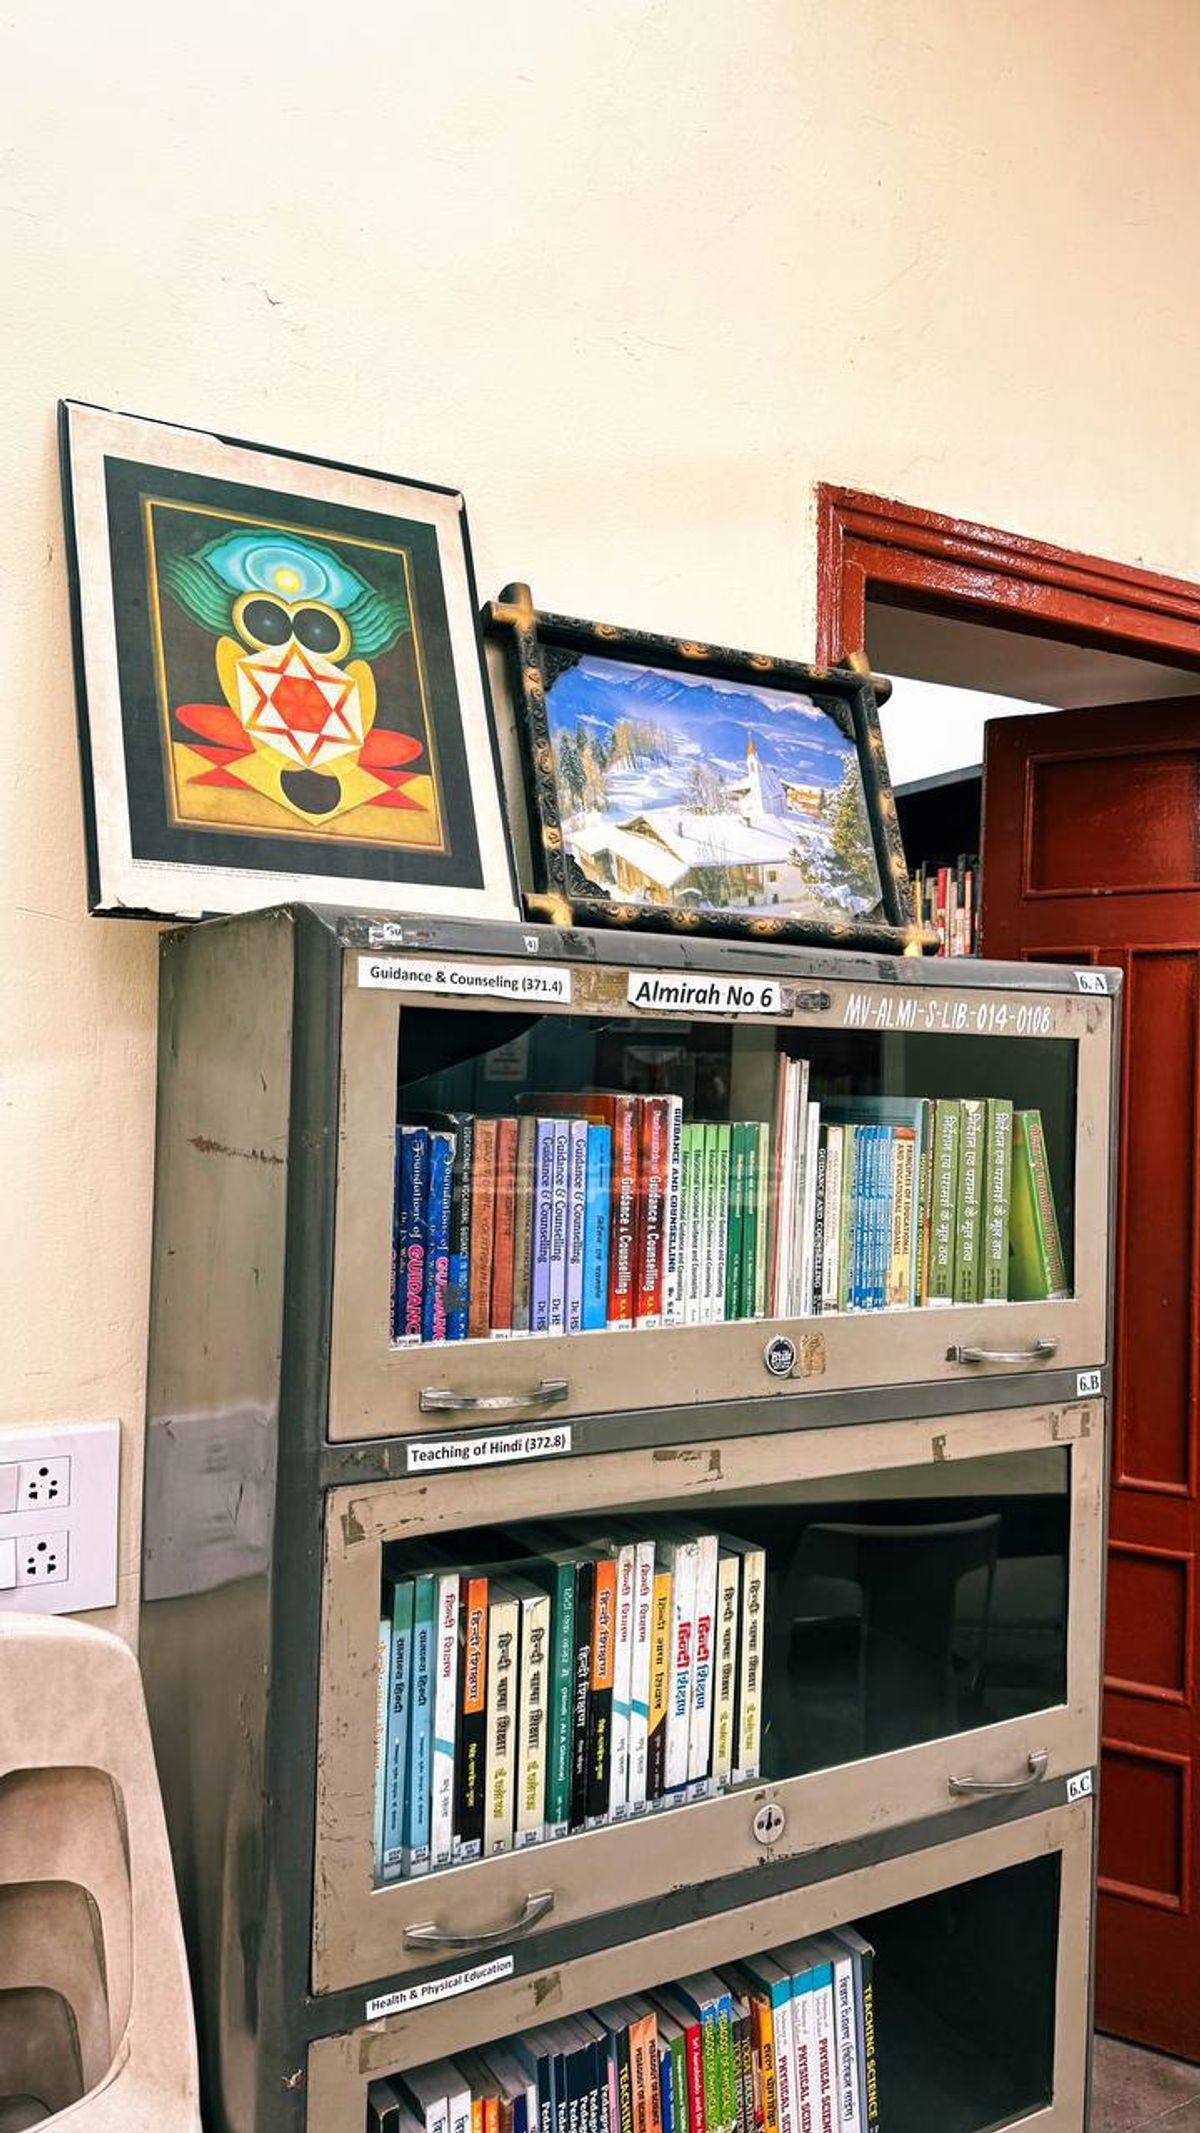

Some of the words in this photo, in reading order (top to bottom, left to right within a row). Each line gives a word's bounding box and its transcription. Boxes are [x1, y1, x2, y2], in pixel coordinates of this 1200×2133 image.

[370, 966, 431, 983] Guidance
[435, 971, 446, 984] &
[450, 972, 519, 991] Counseling
[521, 977, 563, 995] (371.4)
[635, 981, 720, 1005] Almirah
[726, 985, 754, 1007] No
[760, 987, 773, 1007] 6
[672, 1109, 681, 1165] GUIDANCE
[541, 1137, 552, 1187] Guidance
[556, 1136, 568, 1185] Guidance
[574, 1139, 586, 1188] Guidance
[693, 1150, 701, 1185] Educational
[817, 1148, 825, 1196] GUIDANCE
[904, 1145, 912, 1186] PRINCIPLES
[412, 1140, 424, 1222] Foundations
[441, 1154, 454, 1235] Foundations
[541, 1189, 551, 1201] &
[556, 1187, 566, 1199] &
[574, 1191, 585, 1202] &
[647, 1176, 660, 1222] Guidance
[671, 1168, 679, 1192] AND
[895, 1163, 903, 1213] VOCATIONAL
[903, 1189, 911, 1200] OF
[619, 1177, 631, 1224] Guidance
[410, 1227, 422, 1239] of
[437, 1239, 447, 1252] of
[538, 1202, 550, 1263] Counselling
[552, 1200, 565, 1262] Counselling
[571, 1203, 583, 1264] Counselling
[668, 1195, 678, 1273] COUNSELLING
[678, 1222, 686, 1250] Guidance
[692, 1220, 700, 1249] Guidance
[718, 1220, 726, 1248] Guidance
[893, 1216, 901, 1255] GUIDANCE
[616, 1235, 628, 1294] Counselling
[643, 1233, 659, 1291] Counselling
[814, 1222, 823, 1288] COUNSELLING
[690, 1264, 698, 1299] Counselling
[704, 1263, 712, 1298] Counselling
[716, 1262, 724, 1297] Counselling
[537, 1301, 546, 1314] Dr.
[552, 1298, 561, 1312] Dr.
[571, 1301, 579, 1314] Dr.
[1080, 1375, 1099, 1391] 6.B
[412, 1446, 469, 1462] Teaching
[474, 1442, 486, 1456] of
[490, 1439, 522, 1454] Hindi
[525, 1434, 566, 1453] (372.8)
[620, 1562, 631, 1596] हिन्दी
[639, 1564, 650, 1597] हिन्दी
[748, 1580, 760, 1615] हिन्दी
[445, 1594, 455, 1628] हिन्दी
[599, 1590, 610, 1625] हिन्दी
[620, 1603, 630, 1643] शिक्षण
[639, 1604, 648, 1643] शिक्षण
[656, 1597, 668, 1630] हिन्दी
[723, 1588, 734, 1622] हिन्दी
[470, 1610, 482, 1648] हिन्दी
[530, 1628, 543, 1666] हिन्दी
[677, 1622, 691, 1667] हिन्दी
[697, 1616, 710, 1661] हिन्दी
[442, 1637, 454, 1677] शिक्षण
[497, 1633, 511, 1672] हिन्दी
[578, 1645, 589, 1678] हिन्दी
[597, 1630, 608, 1677] शिक्षण
[418, 1676, 429, 1707] हिन्दी
[468, 1651, 480, 1701] शिक्षण
[676, 1670, 690, 1717] शिक्षण
[696, 1664, 709, 1710] शिक्षण
[393, 1685, 405, 1713] हिन्दी
[560, 1688, 568, 1715] (Hindi
[575, 1682, 589, 1727] शिक्षण
[560, 1723, 566, 1733] At
[560, 1736, 566, 1744] A
[1070, 1775, 1090, 1797] 6.C
[371, 1993, 406, 2011] Health
[409, 1991, 417, 1999] &
[421, 1975, 462, 1996] Physical
[464, 1960, 512, 1983] Education
[719, 2009, 727, 2054] PEDAGOGY
[863, 1983, 874, 2056] TEACHING
[734, 2041, 742, 2076] YOGA
[742, 2037, 752, 2071] YOGA
[798, 2045, 809, 2101] PHYSICAL
[818, 2038, 829, 2093] PHYSICAL
[778, 2055, 789, 2113] PHYSICAL
[867, 2060, 878, 2121] SCIENCE
